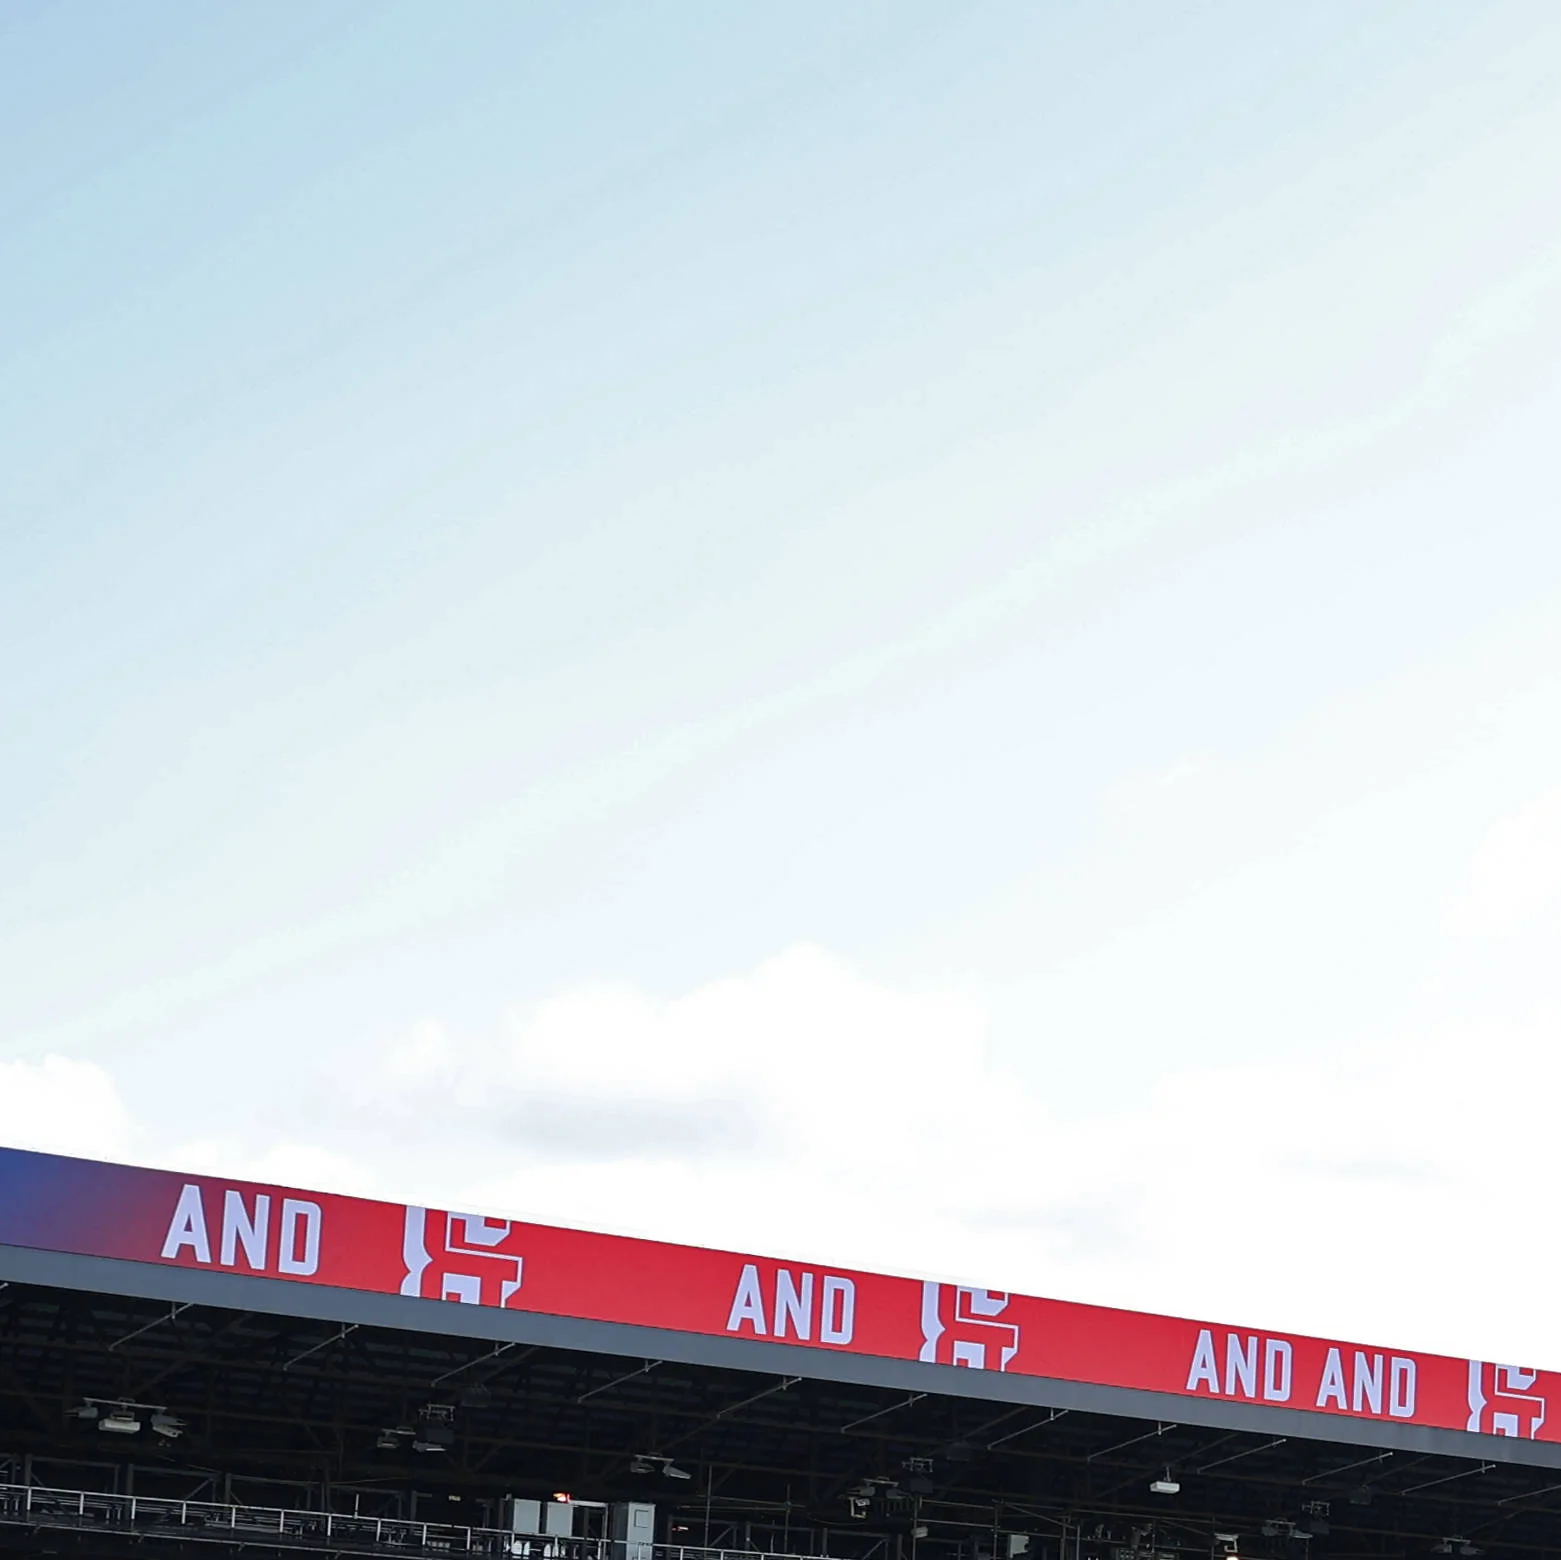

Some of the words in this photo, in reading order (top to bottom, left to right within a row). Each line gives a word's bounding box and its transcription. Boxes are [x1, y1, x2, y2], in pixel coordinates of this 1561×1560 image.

[160, 1184, 323, 1277] AND
[726, 1264, 856, 1346] AND
[1186, 1329, 1293, 1402] AND
[1315, 1347, 1417, 1418] AND
